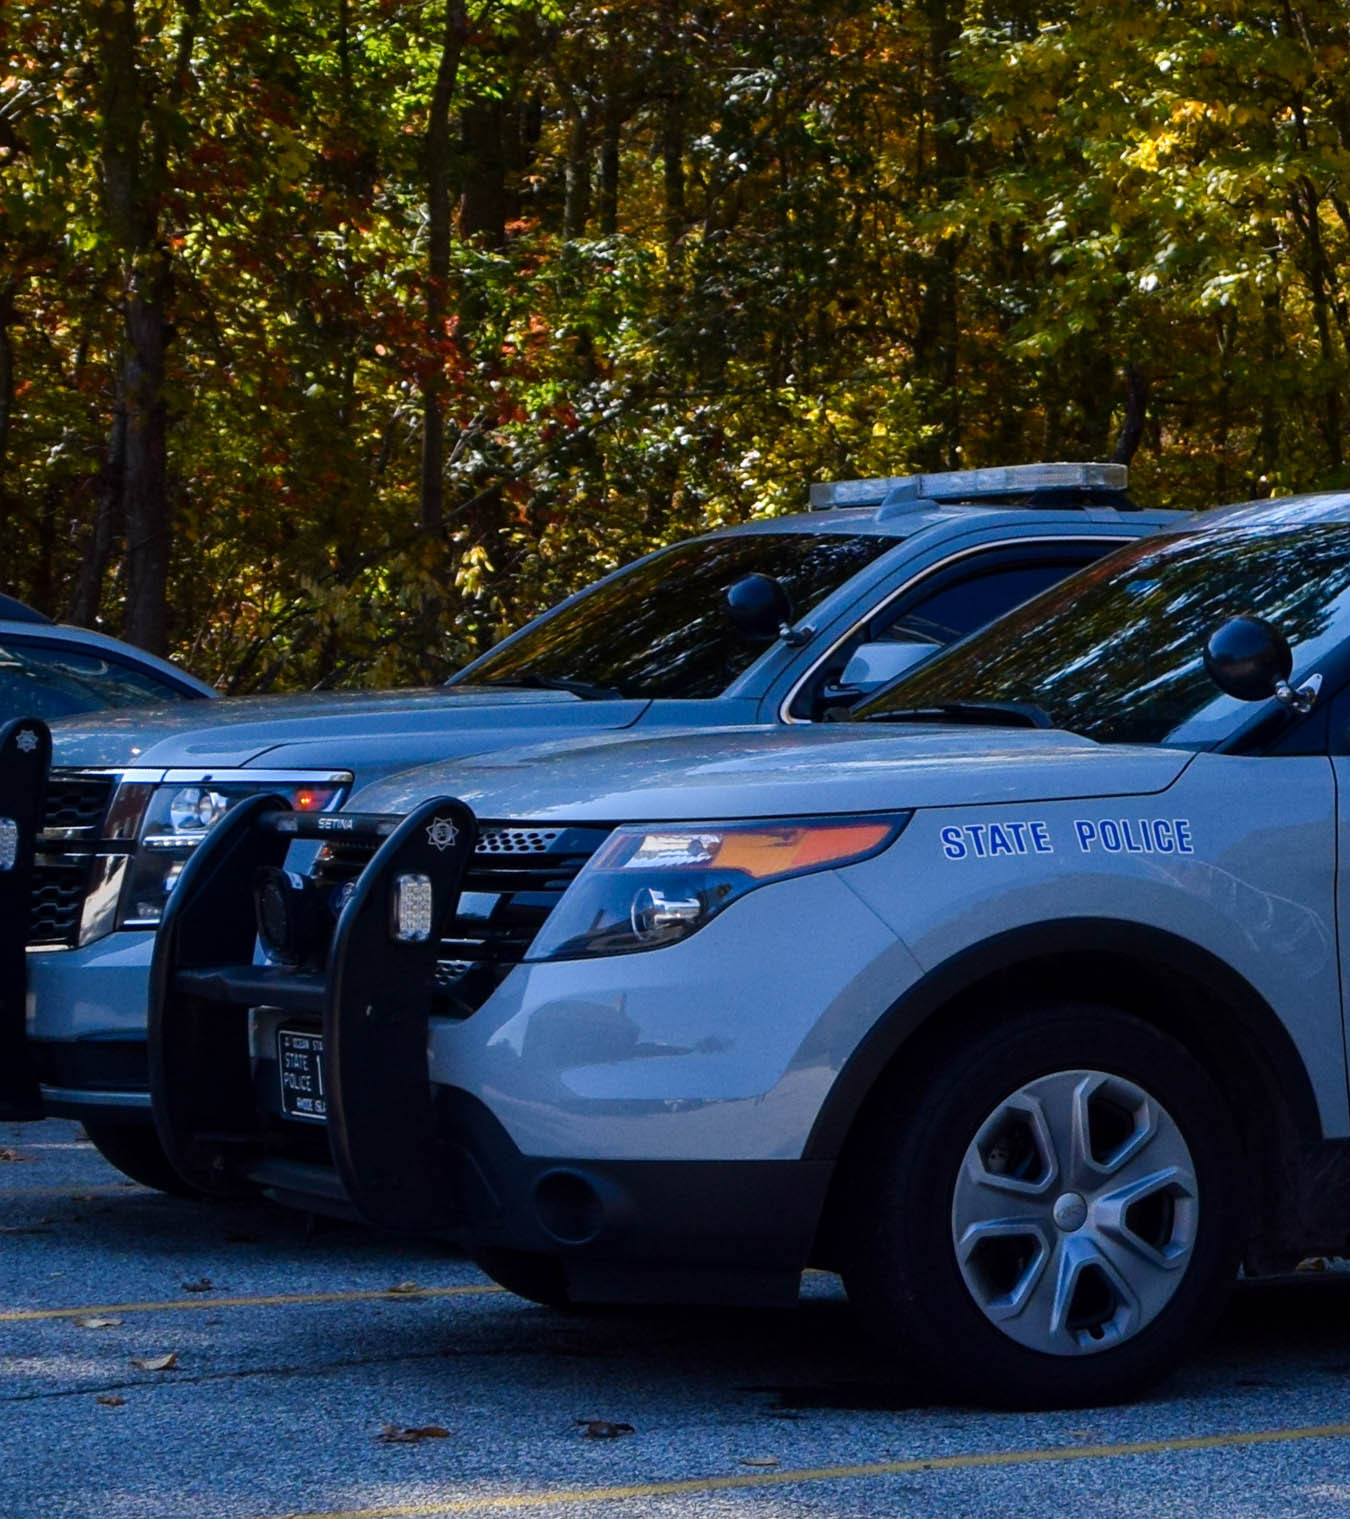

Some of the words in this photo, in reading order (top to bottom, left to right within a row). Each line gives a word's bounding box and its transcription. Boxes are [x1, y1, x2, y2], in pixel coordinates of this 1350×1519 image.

[317, 817, 353, 830] SETINA
[940, 820, 1054, 860] STATE
[1074, 818, 1194, 854] POLICE
[284, 1052, 309, 1071] STATE
[283, 1071, 312, 1092] POLICE
